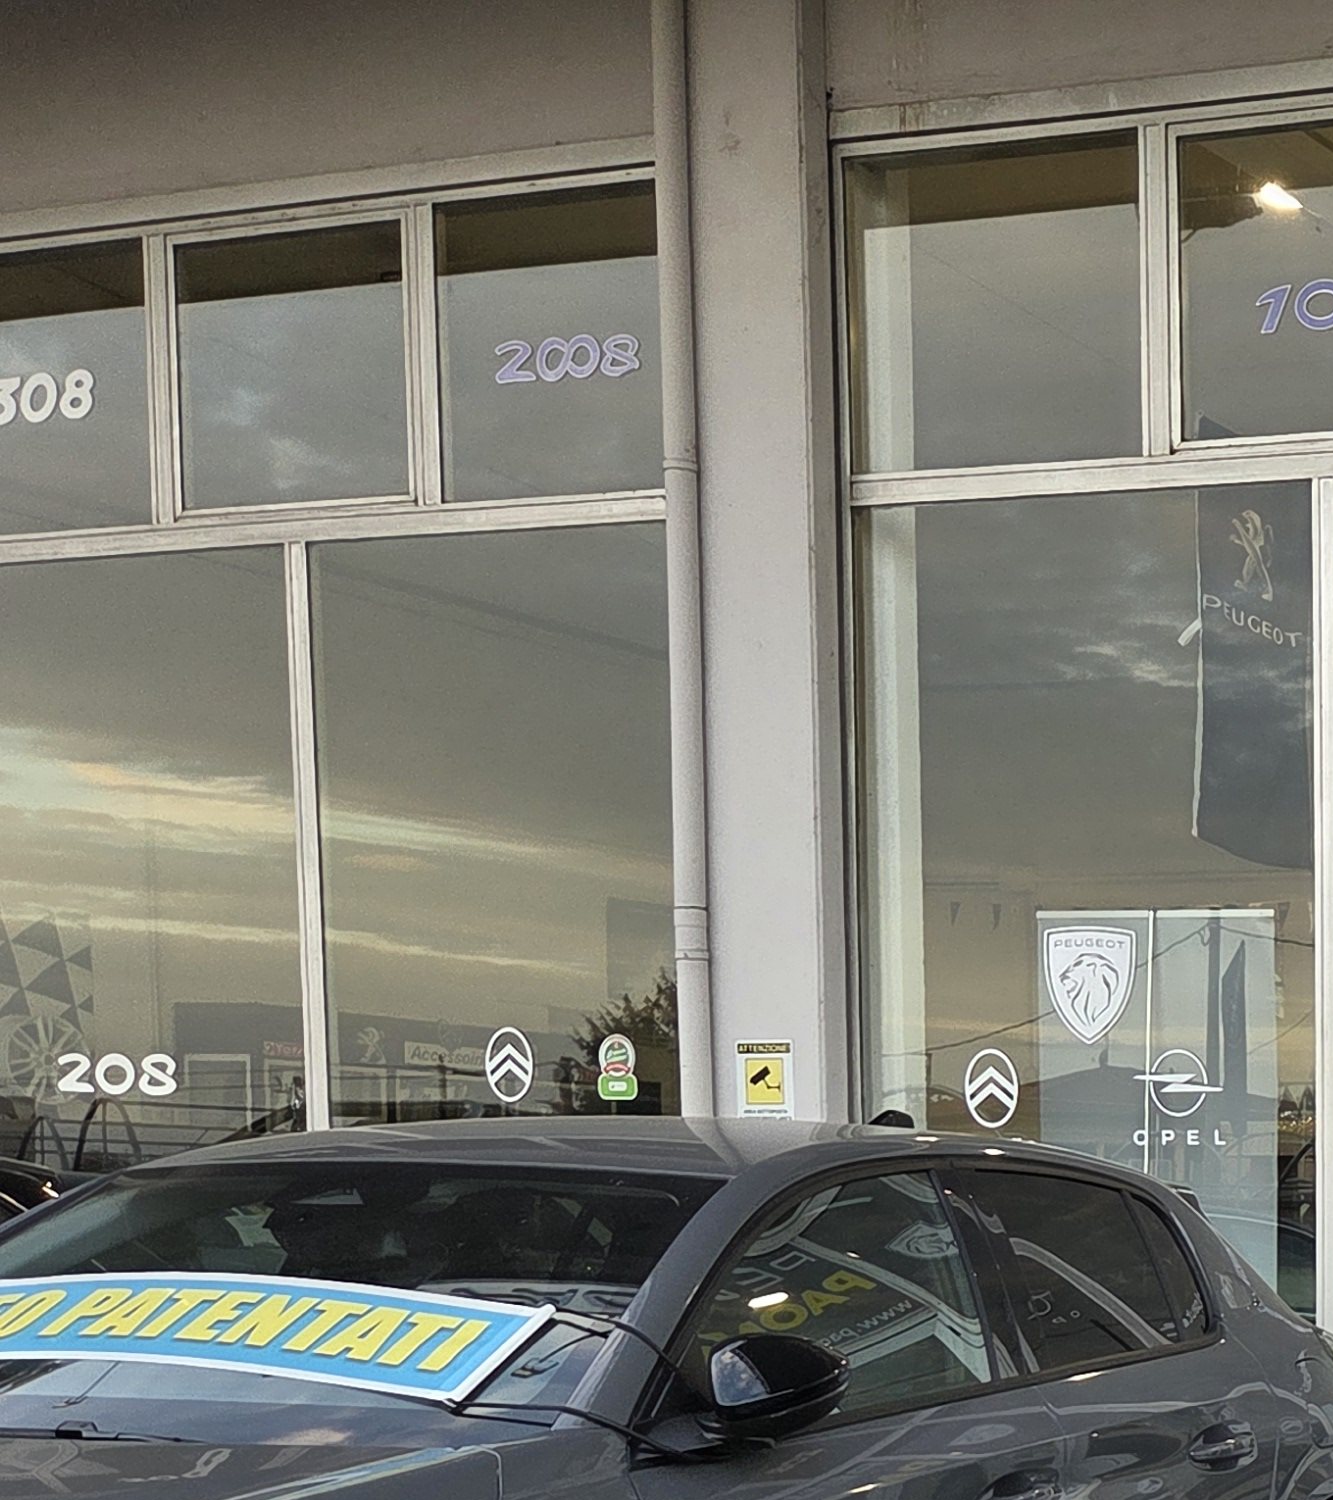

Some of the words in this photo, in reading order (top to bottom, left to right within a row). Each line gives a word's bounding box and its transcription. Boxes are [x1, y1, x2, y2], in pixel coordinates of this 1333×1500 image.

[495, 334, 640, 385] 2008
[1202, 593, 1303, 648] PEUGEOT
[1053, 938, 1126, 951] PEUGEOT
[57, 1053, 177, 1096] 208
[1133, 1130, 1226, 1147] OPEL
[38, 1287, 492, 1372] PATENTATI
